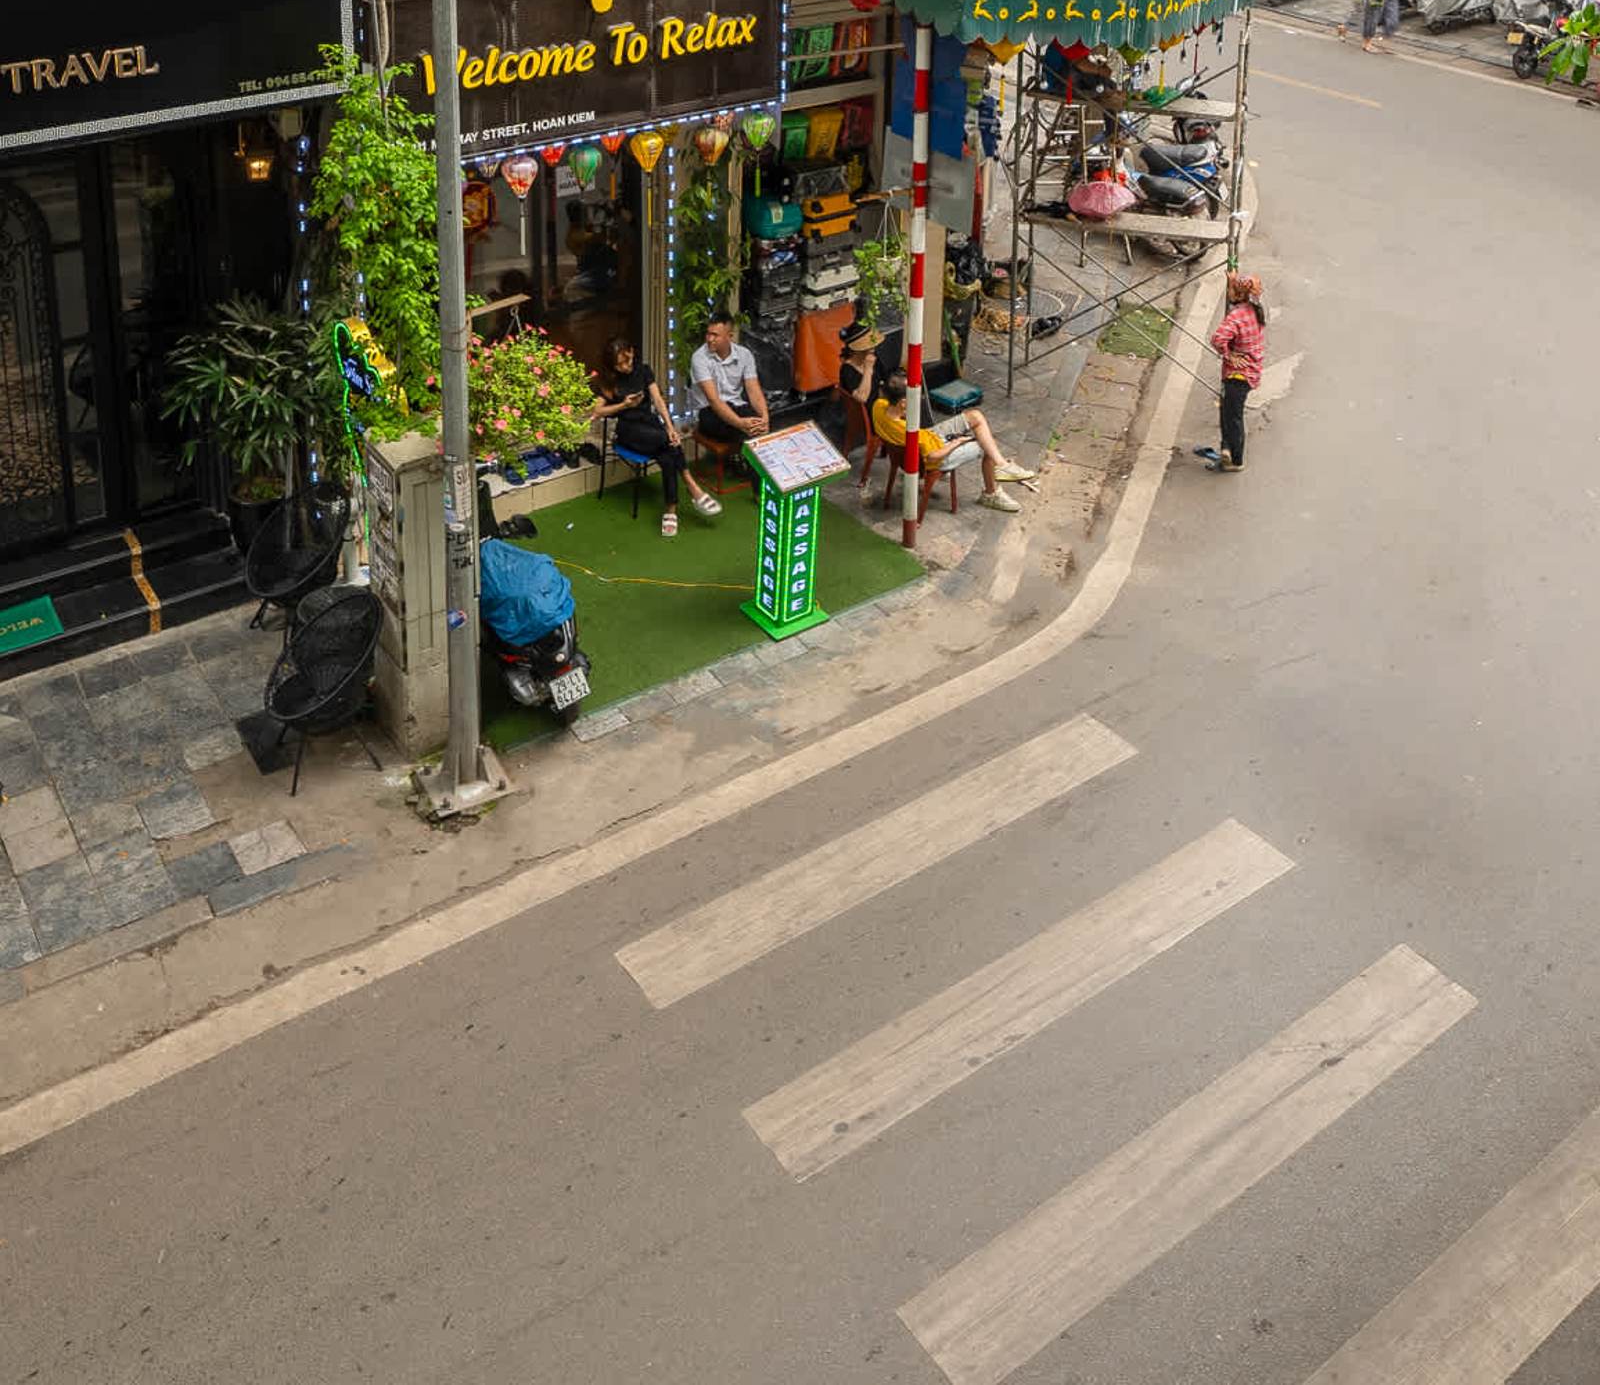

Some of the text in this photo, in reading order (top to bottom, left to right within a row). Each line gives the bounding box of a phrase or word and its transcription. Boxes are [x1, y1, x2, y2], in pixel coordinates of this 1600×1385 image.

[609, 22, 648, 66] To
[660, 13, 757, 60] Relax
[0, 45, 160, 94] TRAVEL
[482, 123, 530, 141] STREET,
[532, 115, 566, 132] HOAN
[567, 110, 596, 126] KIEM
[762, 483, 778, 609] ASSAGE
